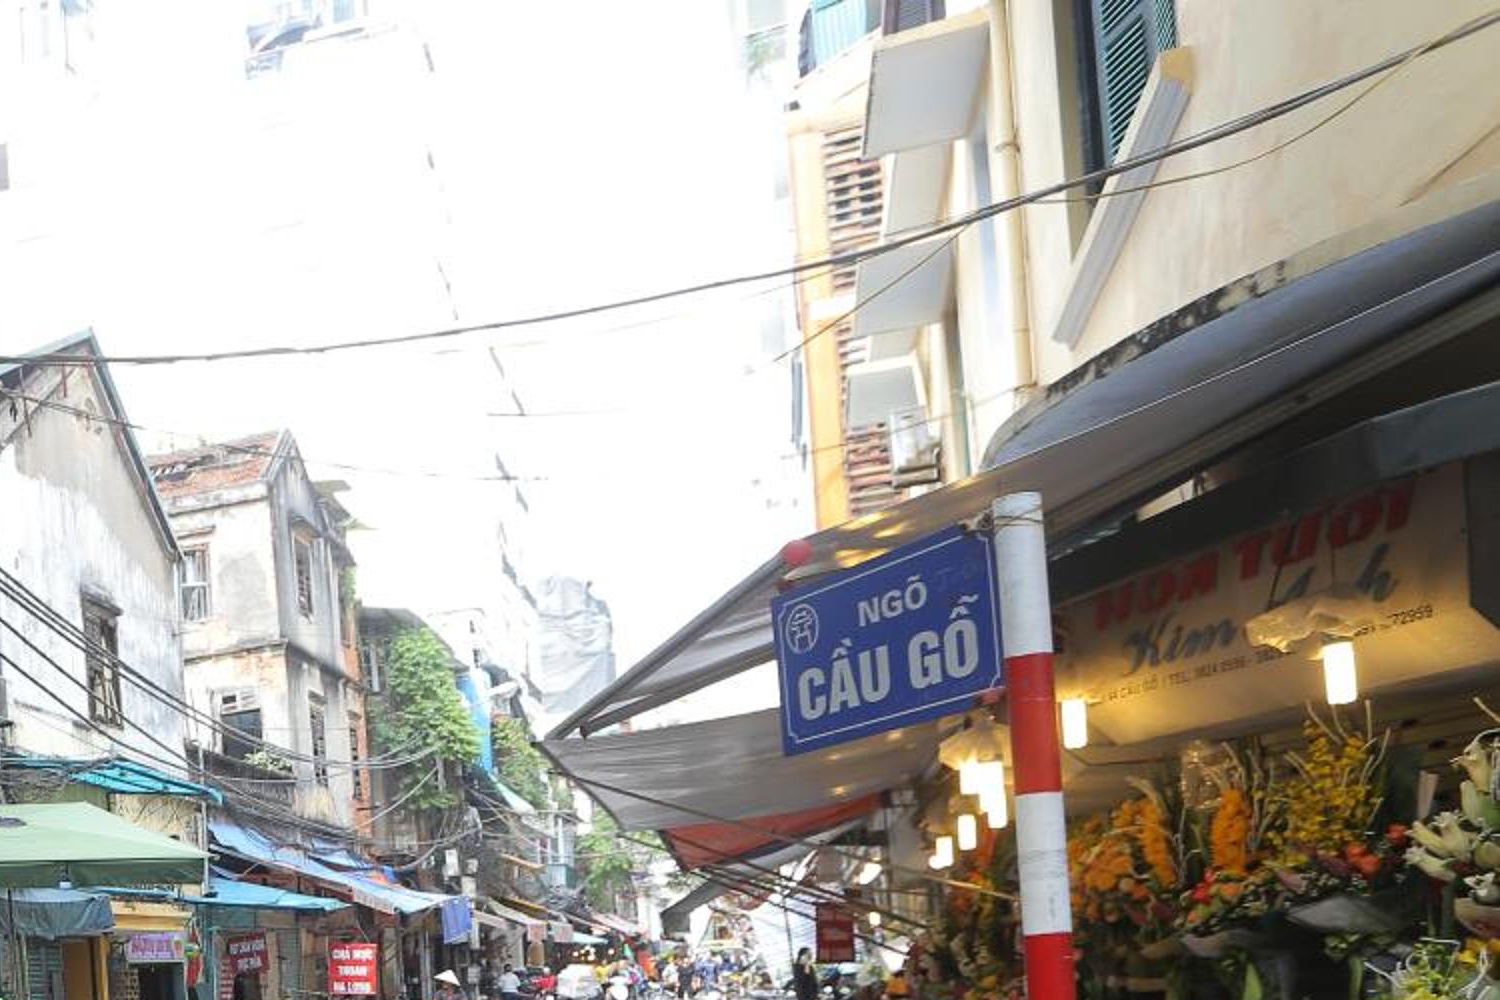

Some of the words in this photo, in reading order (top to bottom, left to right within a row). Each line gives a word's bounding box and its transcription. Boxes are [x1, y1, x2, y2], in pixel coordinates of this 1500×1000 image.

[857, 574, 927, 627] NGÕ
[799, 637, 890, 721] CẦU
[908, 593, 979, 689] GỖ
[1122, 610, 1238, 676] Kim
